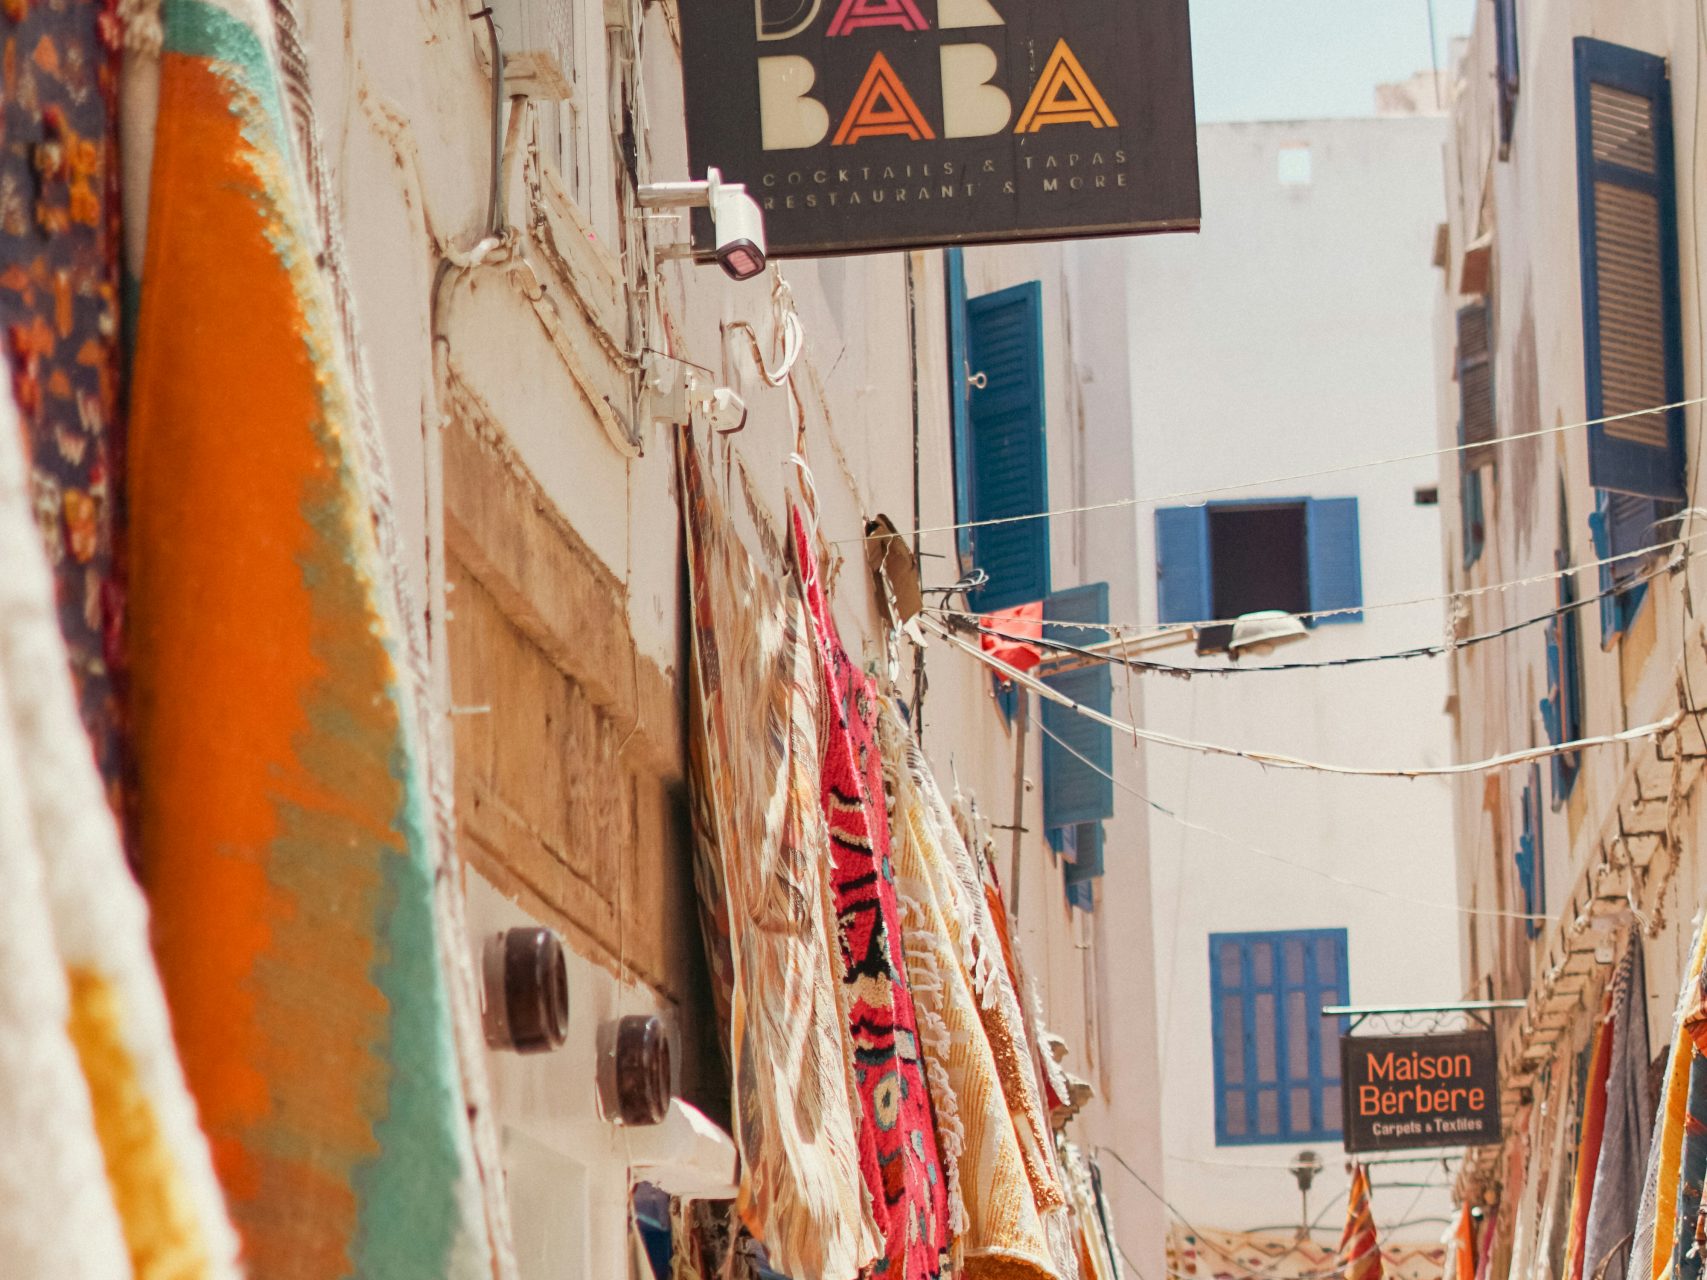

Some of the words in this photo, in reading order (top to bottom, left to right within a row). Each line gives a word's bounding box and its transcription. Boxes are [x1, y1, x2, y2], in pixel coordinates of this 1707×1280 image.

[757, 37, 1120, 151] BABA
[762, 161, 954, 187] COCKTAILS
[982, 159, 995, 172] &
[1023, 150, 1126, 169] TAPAS
[763, 183, 975, 210] RESTAURANT
[1002, 180, 1015, 194] &
[1043, 173, 1128, 192] MORE
[1366, 1051, 1472, 1083] Maison
[1372, 1121, 1422, 1137] Carpets
[1425, 1122, 1433, 1133] &
[1433, 1117, 1483, 1133] Textiles
